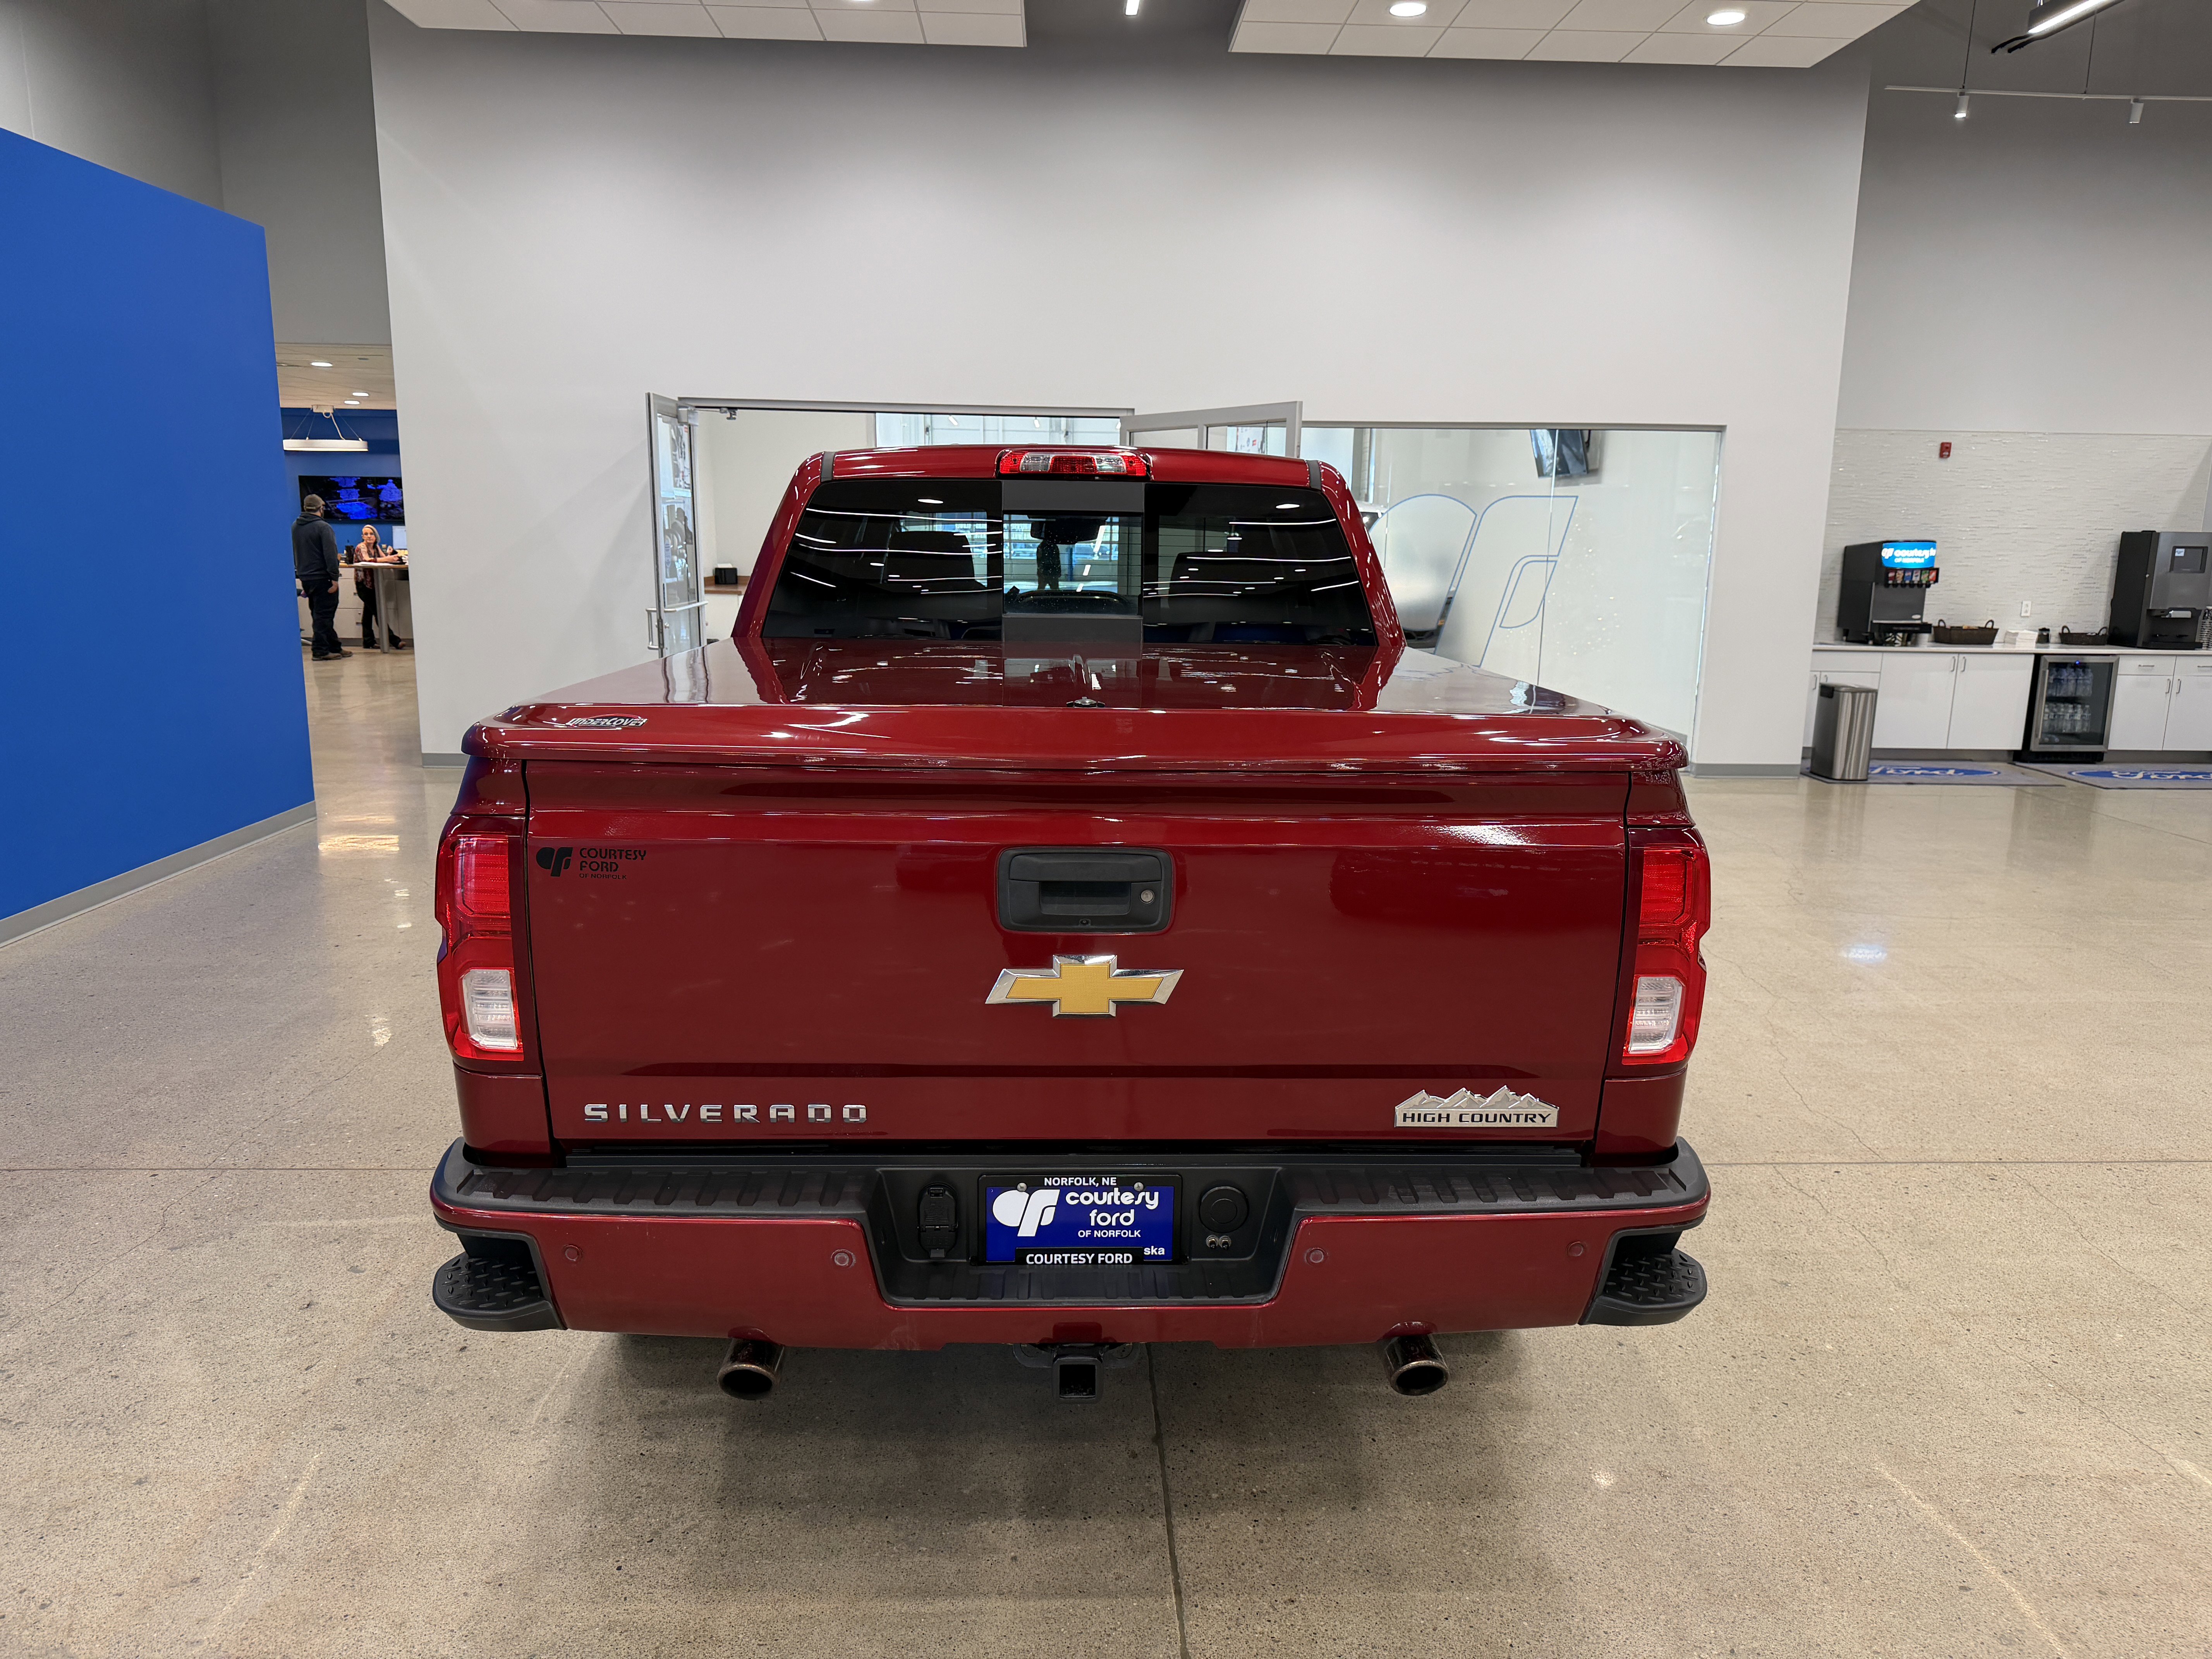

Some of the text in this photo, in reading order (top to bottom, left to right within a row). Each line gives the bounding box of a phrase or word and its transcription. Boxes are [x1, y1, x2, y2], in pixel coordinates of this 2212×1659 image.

[580, 848, 646, 860] COURTESY
[580, 860, 619, 872] FORD
[584, 1104, 867, 1123] SILVERADO
[1402, 1113, 1551, 1123] HIGH COUNTRY
[1044, 1177, 1117, 1187] NORFOLK, NE
[1065, 1187, 1159, 1210] courtesy
[1089, 1209, 1135, 1226] ford
[1026, 1254, 1133, 1265] COURTESY FORD
